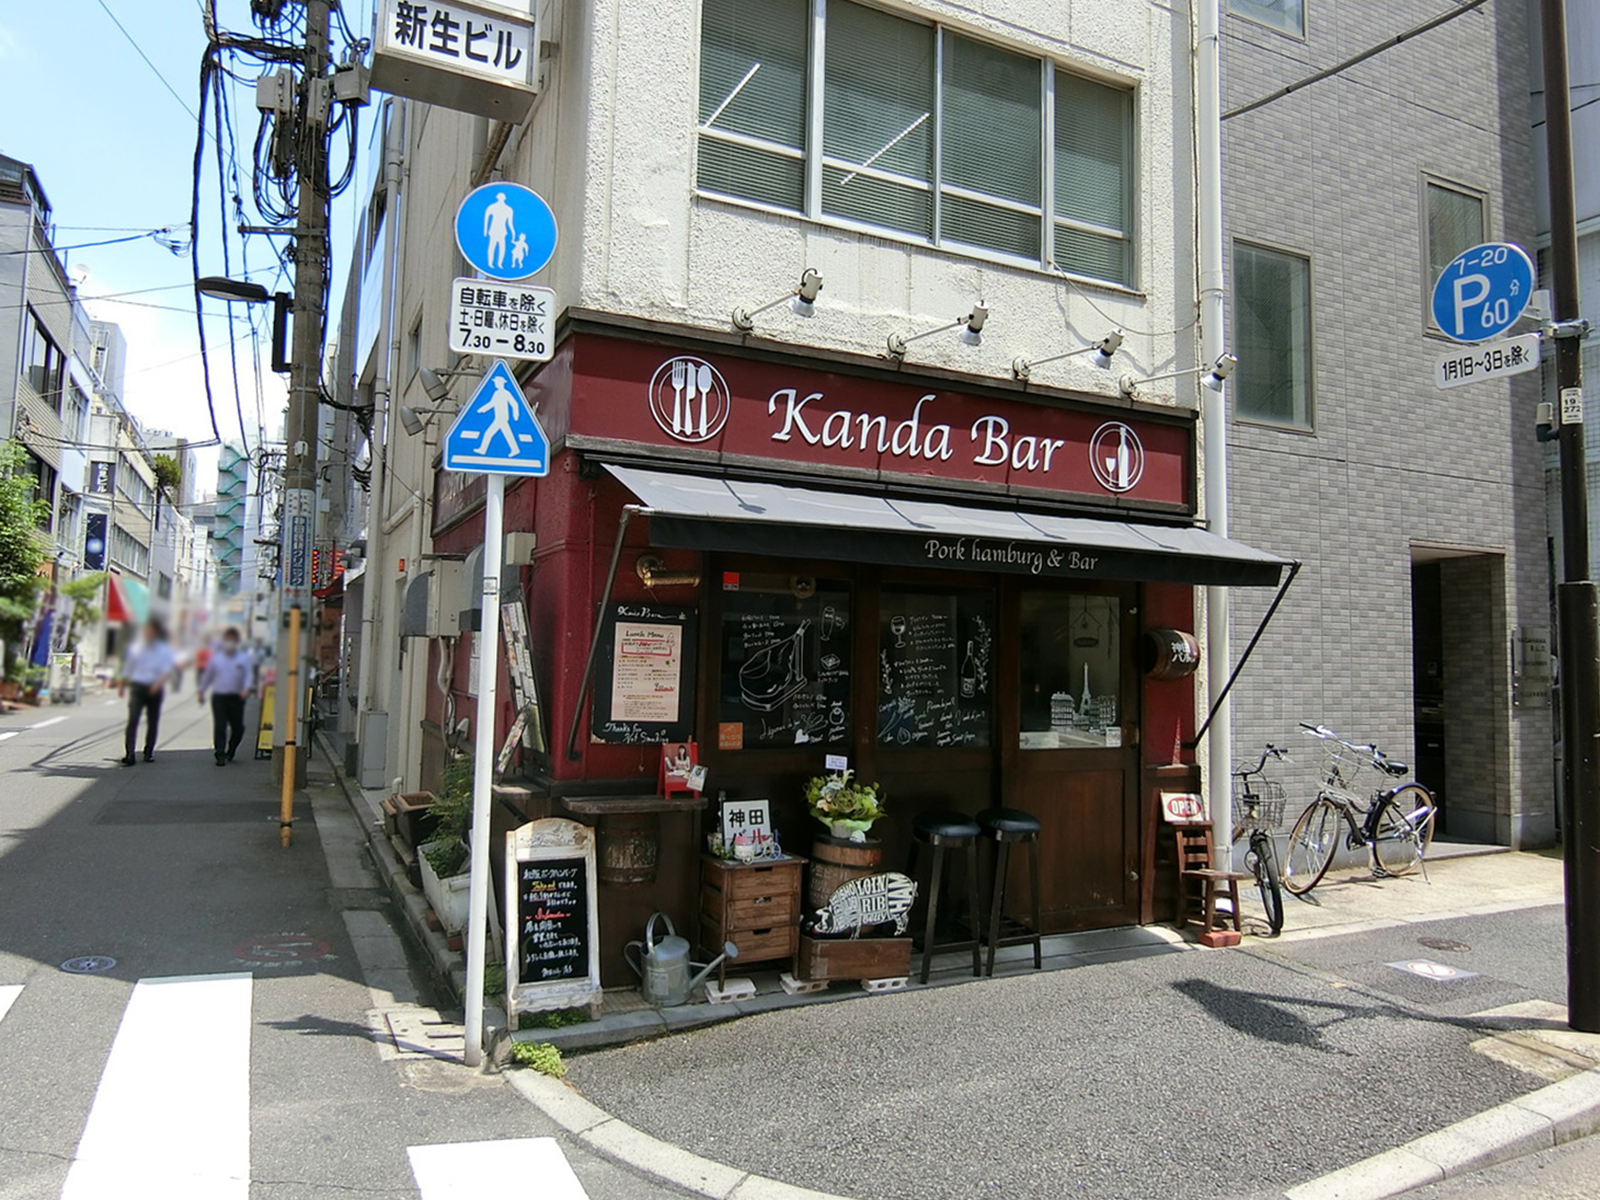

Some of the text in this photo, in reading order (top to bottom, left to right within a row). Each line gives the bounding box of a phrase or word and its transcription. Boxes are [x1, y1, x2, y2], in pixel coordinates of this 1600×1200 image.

[394, 1, 522, 70] 新生ビル
[460, 287, 546, 313] 自転車を除く
[1509, 279, 1520, 296] 分
[1453, 273, 1491, 335] P
[1481, 298, 1509, 328] 60
[768, 388, 1064, 472] Kanda Bar
[924, 537, 1098, 575] Pork hamburg & Bar
[729, 809, 764, 828] 神田
[1170, 800, 1198, 815] OPEN
[857, 875, 886, 896] LOIN
[888, 873, 912, 916] HAM
[862, 896, 886, 914] RIB
